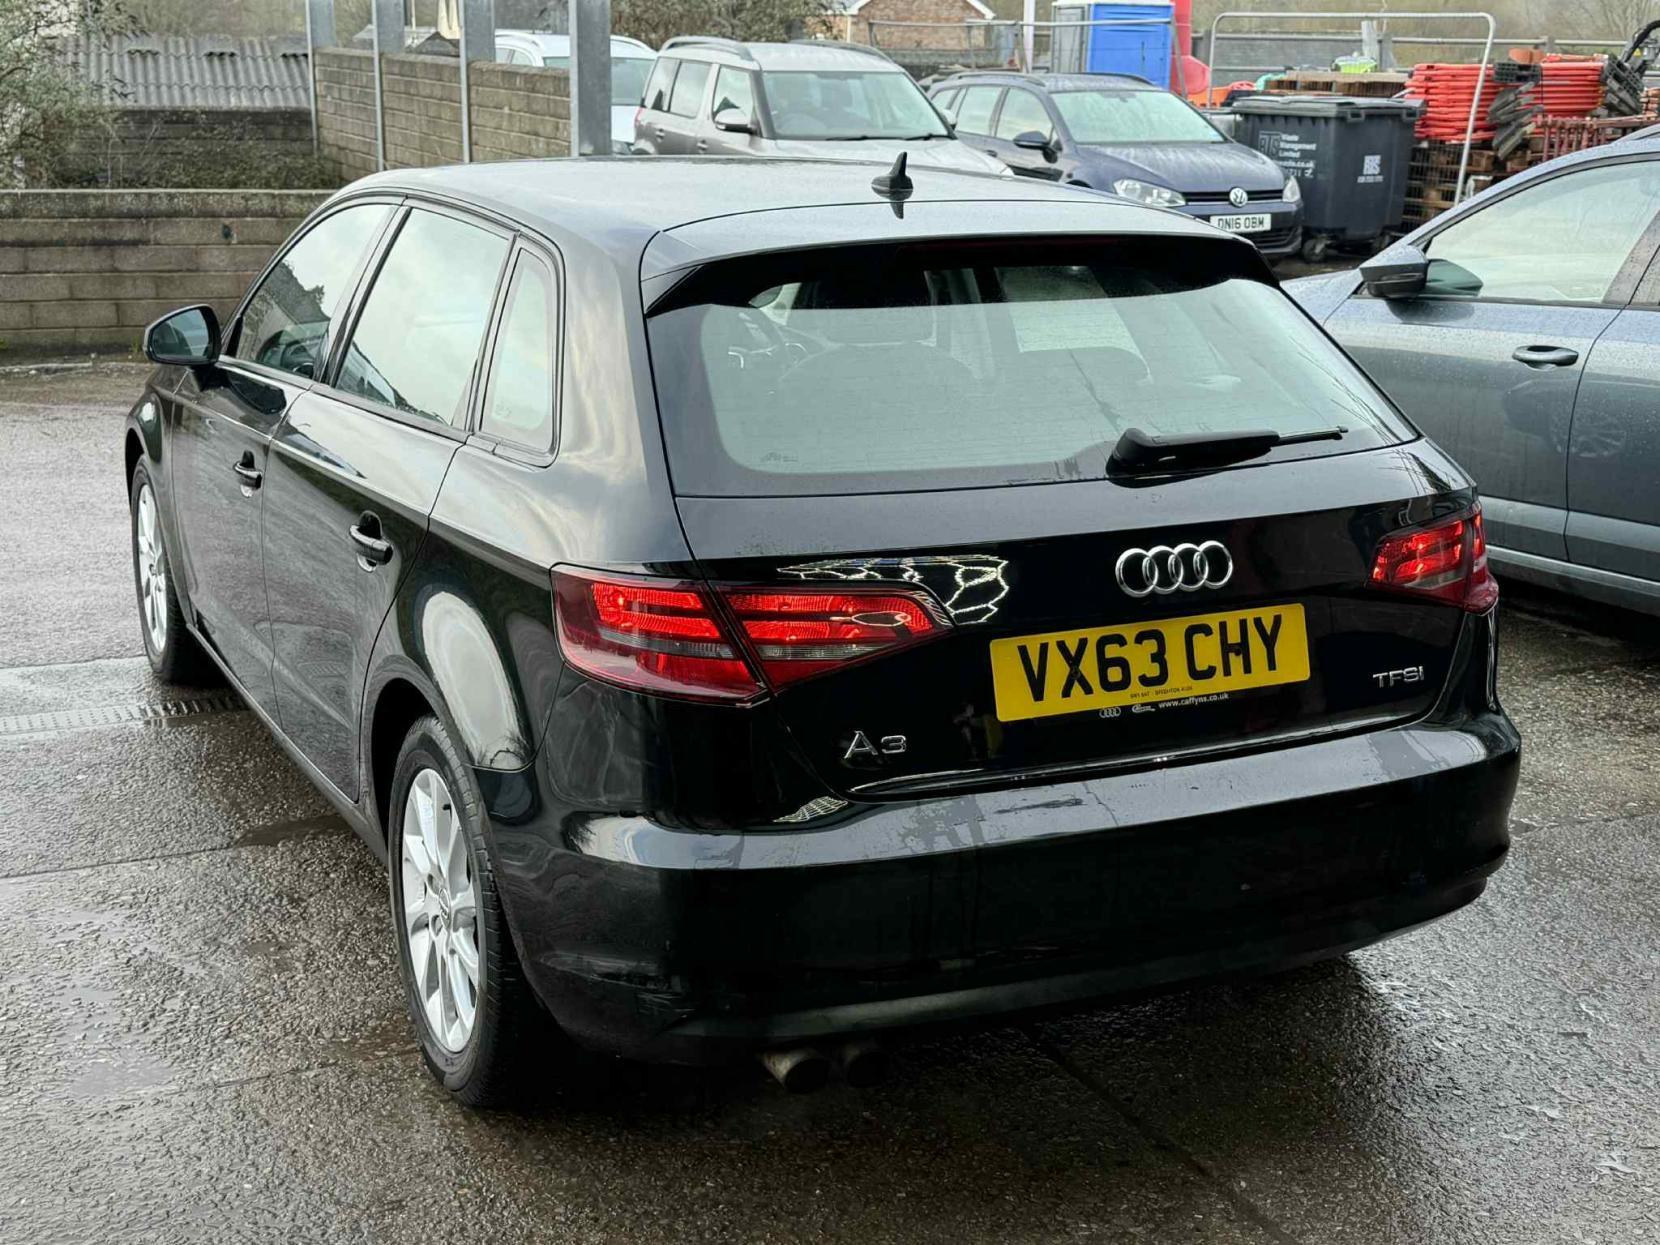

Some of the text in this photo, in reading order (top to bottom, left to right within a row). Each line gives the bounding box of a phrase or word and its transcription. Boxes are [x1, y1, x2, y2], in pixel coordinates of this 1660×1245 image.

[1217, 217, 1241, 230] DN16
[1017, 614, 1283, 703] VX63 CHY
[1372, 665, 1425, 688] TFSI
[1158, 693, 1229, 709] www.caffyns.co.uk
[843, 730, 907, 759] A3
